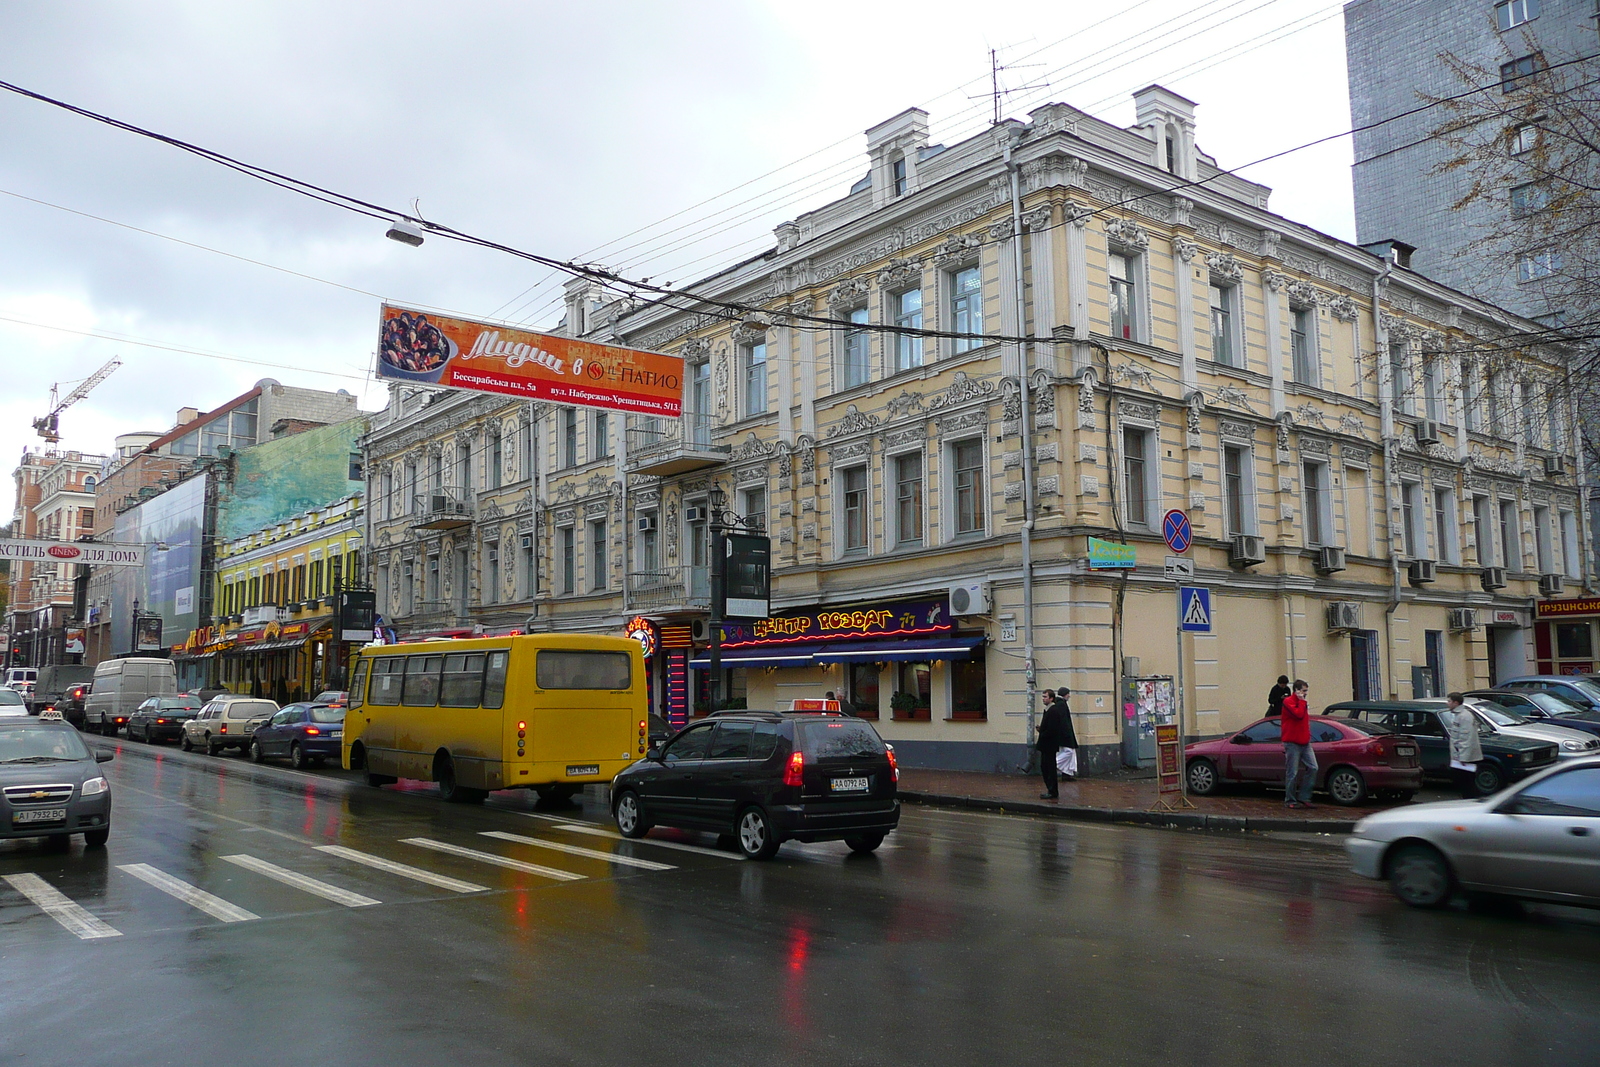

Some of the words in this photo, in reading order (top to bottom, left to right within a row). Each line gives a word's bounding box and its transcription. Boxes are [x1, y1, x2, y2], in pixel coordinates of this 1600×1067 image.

[461, 330, 565, 375] Мидии
[572, 358, 584, 376] в
[453, 371, 509, 387] Бессарабська
[621, 367, 678, 389] ПАТИО
[550, 387, 567, 397] вул.
[50, 547, 78, 557] LINENS
[81, 549, 104, 561] ДЛЯ
[106, 550, 139, 563] ДОМУ
[753, 616, 811, 637] ЦЕНТР
[817, 609, 893, 631] РОЗВАГ
[835, 779, 844, 788] AA
[33, 811, 51, 819] 7932
[52, 809, 64, 818] BC
